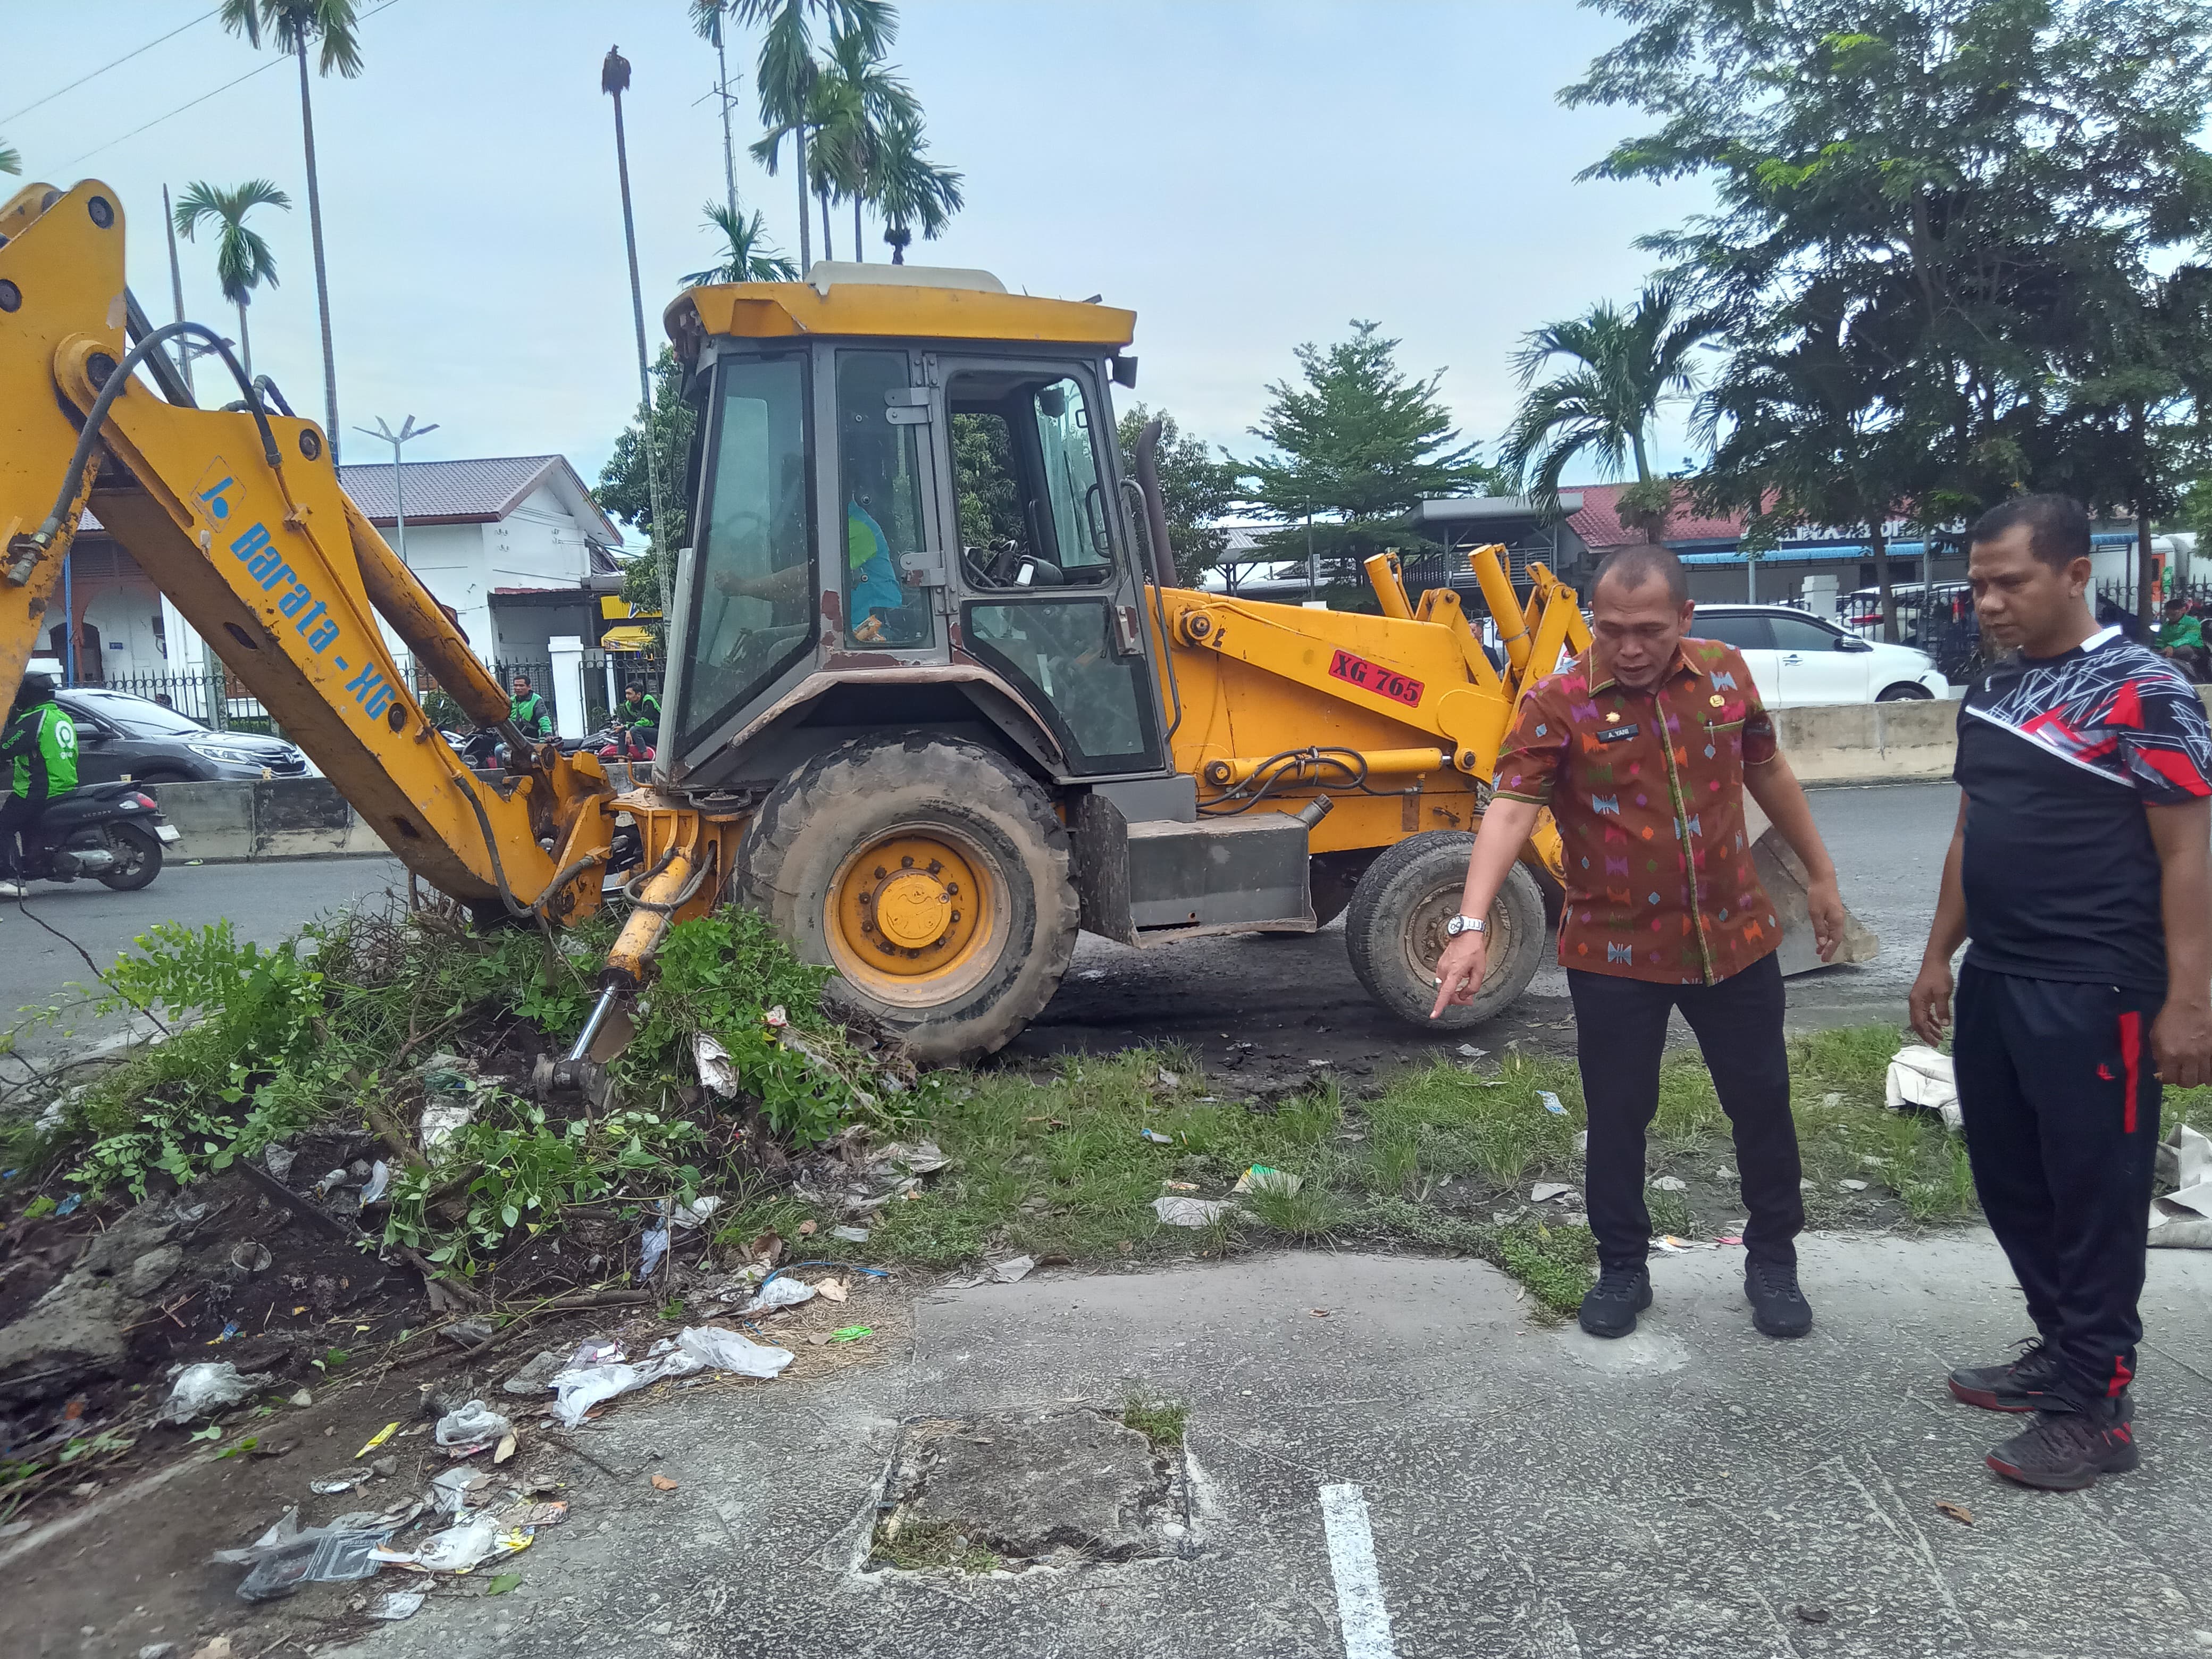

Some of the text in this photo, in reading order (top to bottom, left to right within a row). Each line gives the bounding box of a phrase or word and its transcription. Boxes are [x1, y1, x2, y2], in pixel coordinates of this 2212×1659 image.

[230, 522, 340, 655] Barata
[345, 661, 396, 721] XG
[1333, 654, 1419, 701] XG 765
